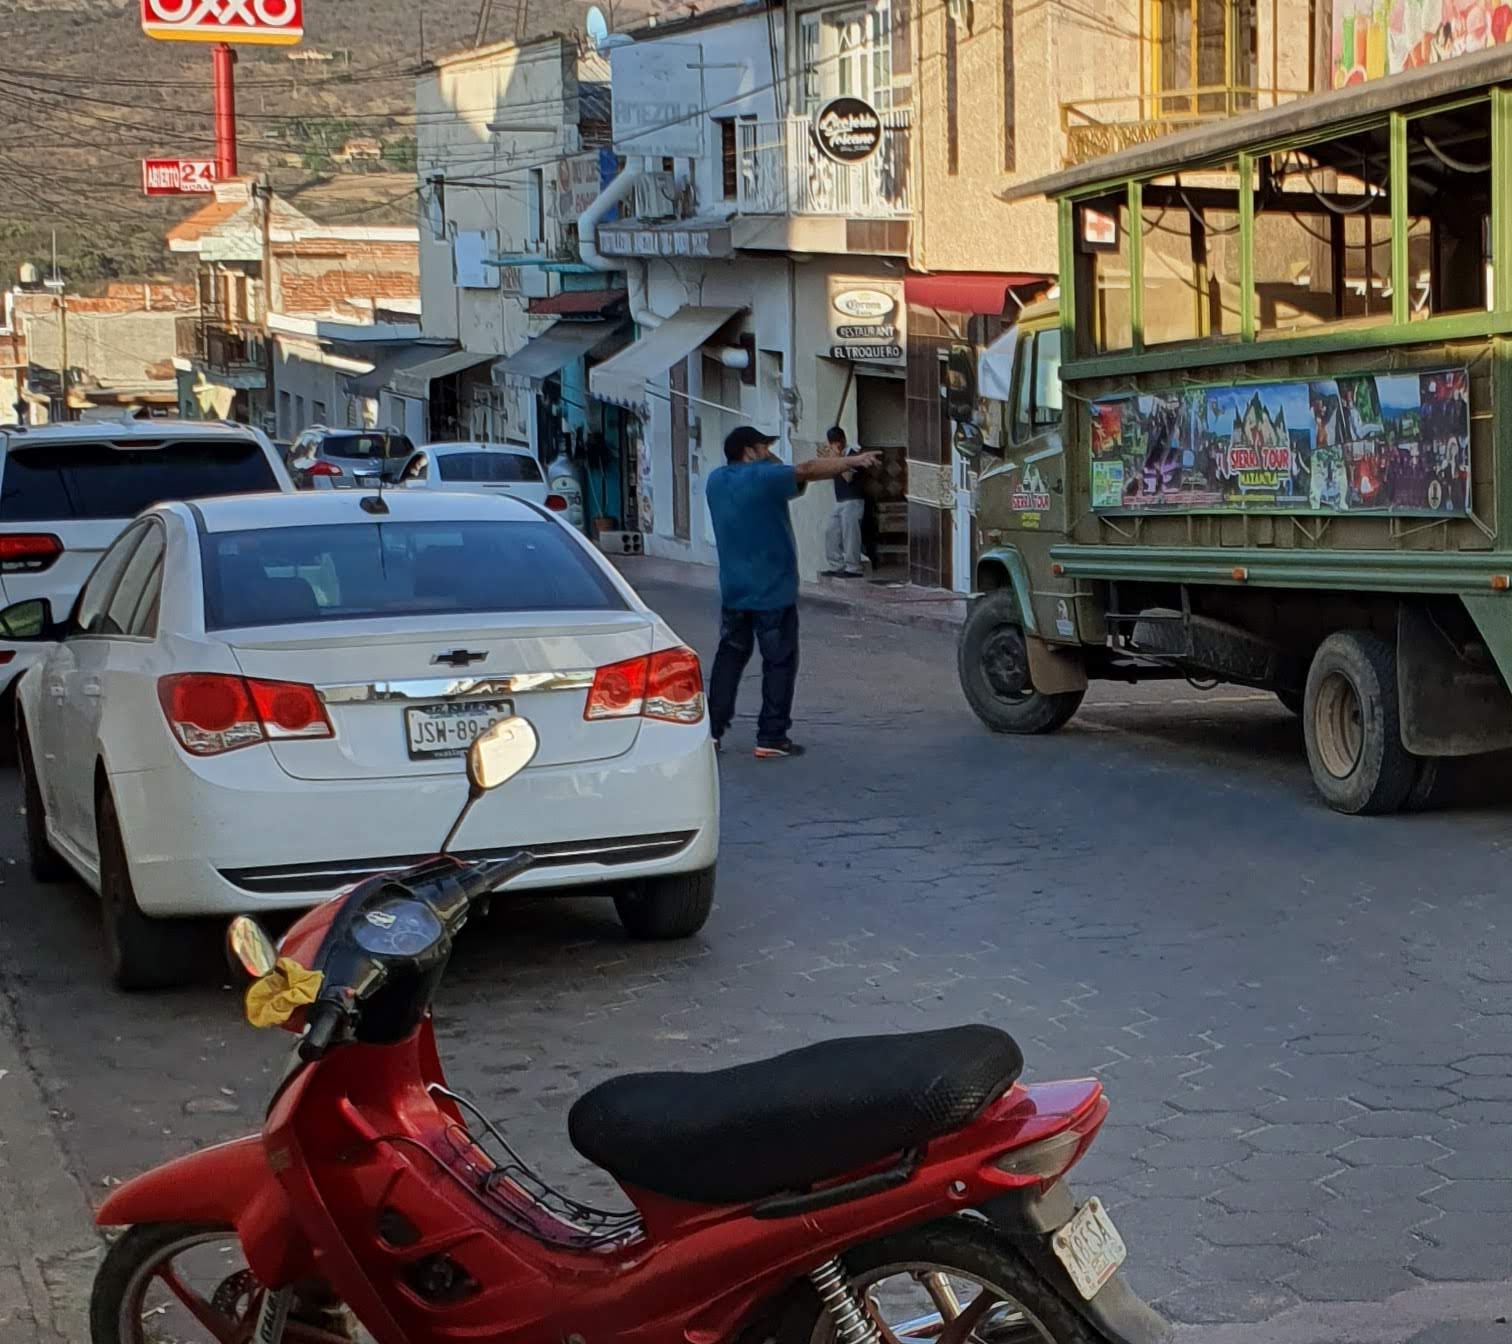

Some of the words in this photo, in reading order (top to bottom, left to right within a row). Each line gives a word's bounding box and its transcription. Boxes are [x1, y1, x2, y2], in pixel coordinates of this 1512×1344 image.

[182, 164, 214, 183] 24
[840, 324, 895, 337] RESTAURANT
[834, 346, 845, 359] EL
[846, 346, 900, 360] TROQUERO
[1261, 447, 1290, 472] TOUR
